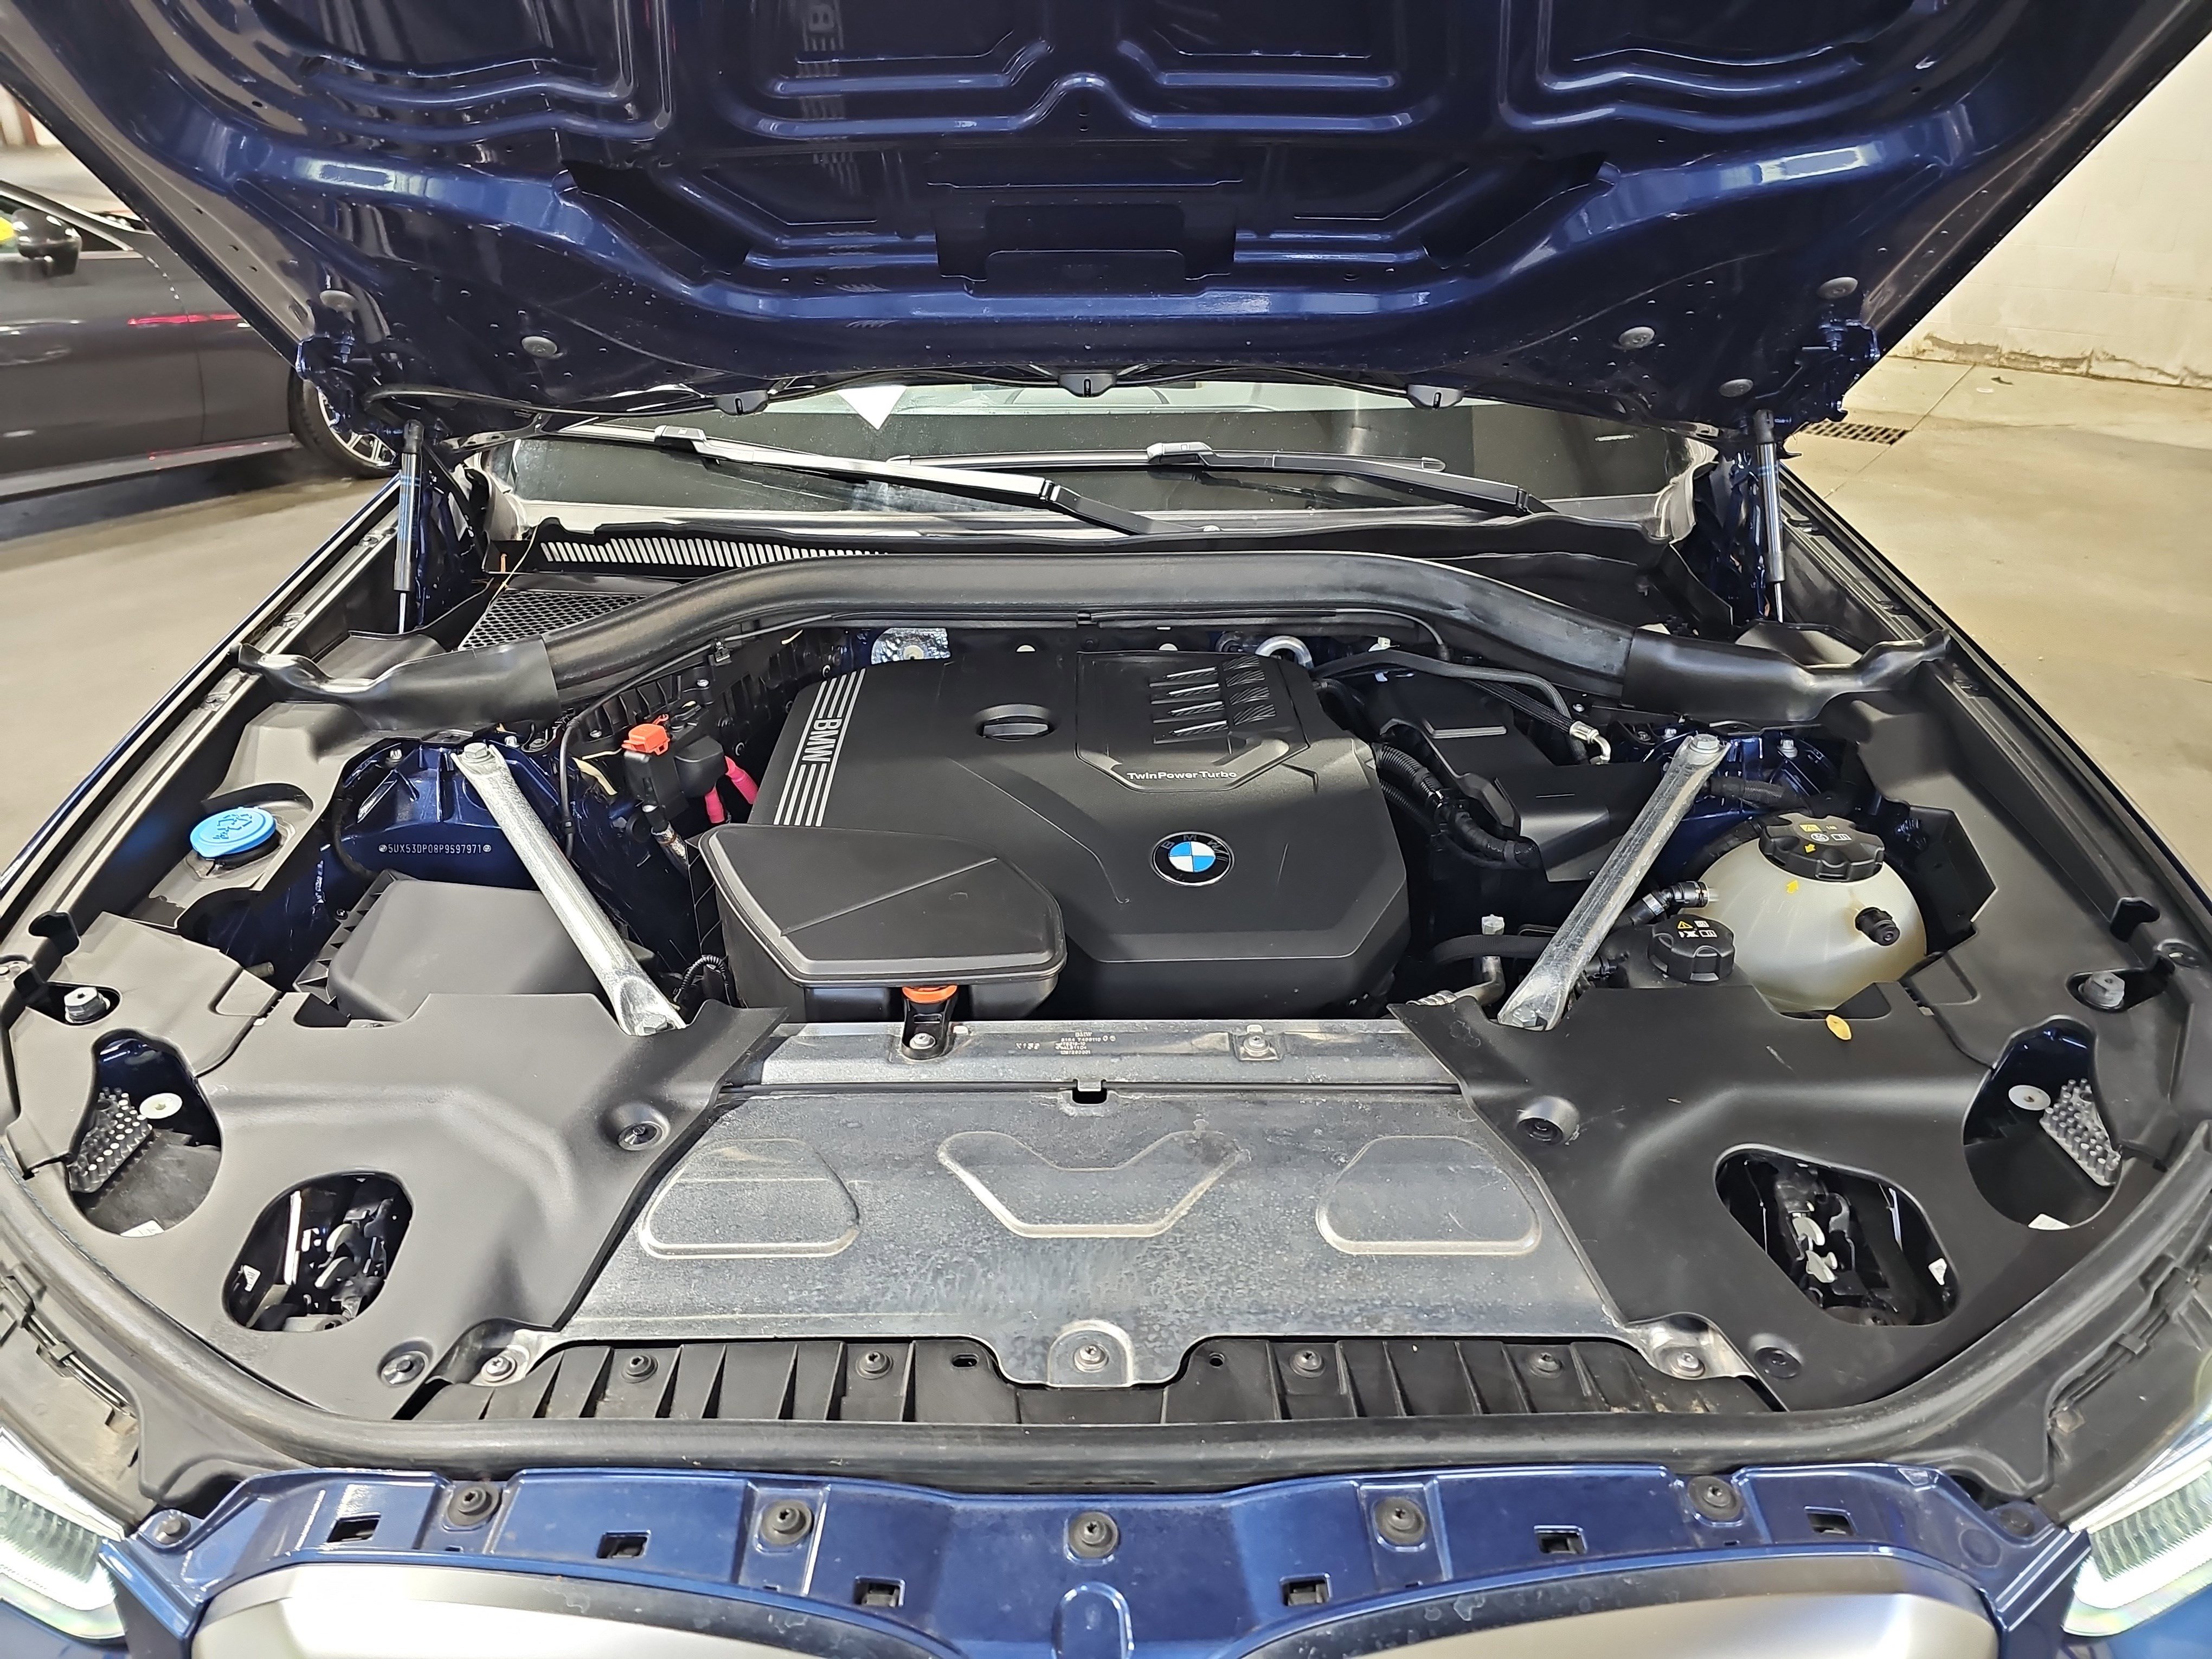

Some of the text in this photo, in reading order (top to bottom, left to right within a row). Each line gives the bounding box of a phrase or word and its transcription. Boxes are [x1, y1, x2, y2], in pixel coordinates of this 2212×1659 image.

[801, 718, 843, 762] BMW
[388, 844, 481, 854] 5UX53DP08P9S97971
[1161, 834, 1229, 856] BMW
